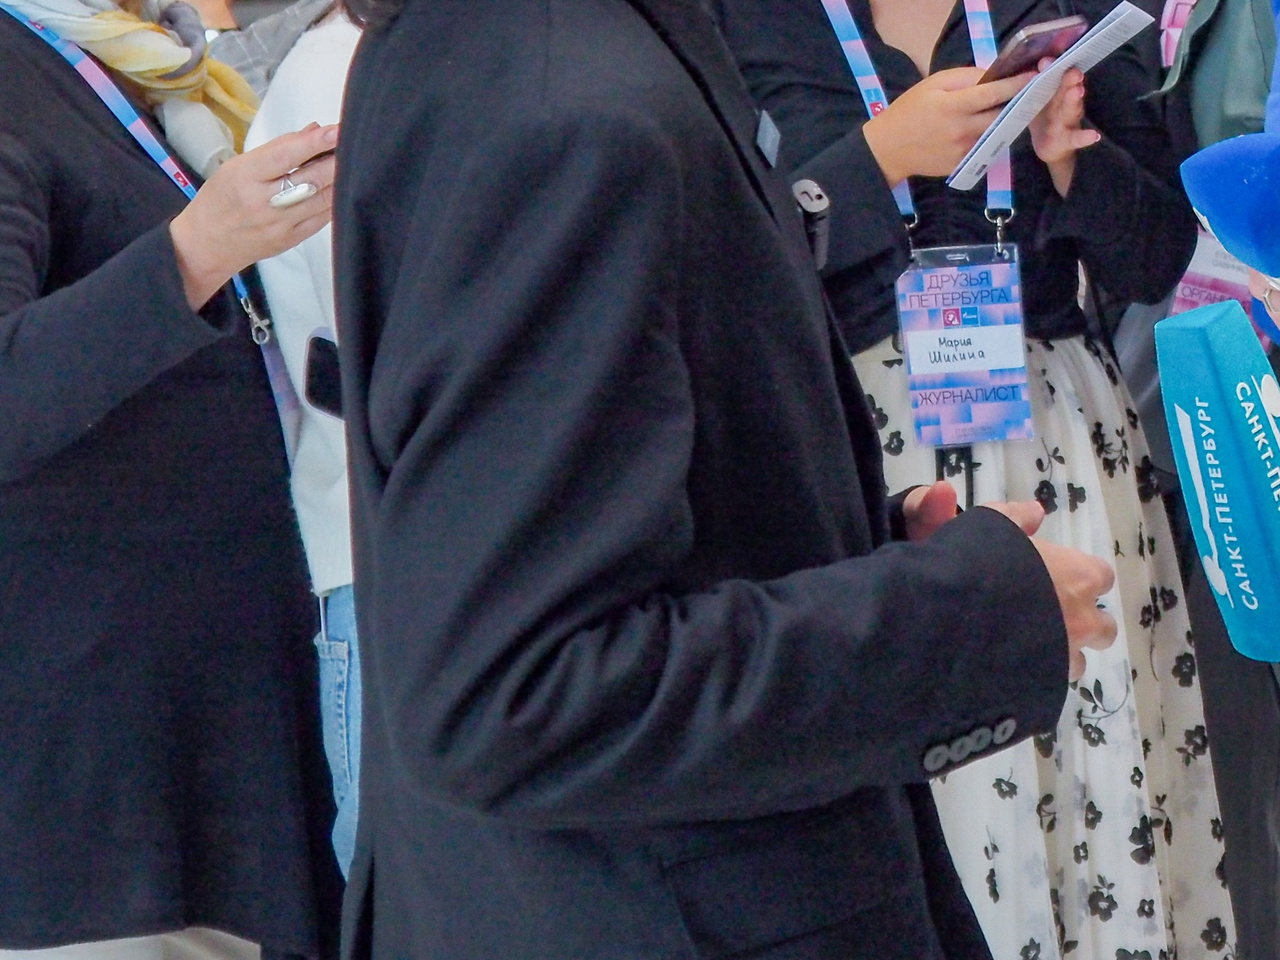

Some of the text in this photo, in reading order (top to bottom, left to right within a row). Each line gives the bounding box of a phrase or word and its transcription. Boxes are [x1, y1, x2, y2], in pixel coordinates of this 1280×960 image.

[927, 271, 990, 290] ДРУЗЬЯ
[909, 288, 1010, 308] ПЕТЕРБУРГА
[938, 337, 973, 350] Мария
[918, 385, 1020, 406] ЖУРНАЛИСТ
[1195, 397, 1259, 610] САНКТ-ПЕТЕРБУРГ
